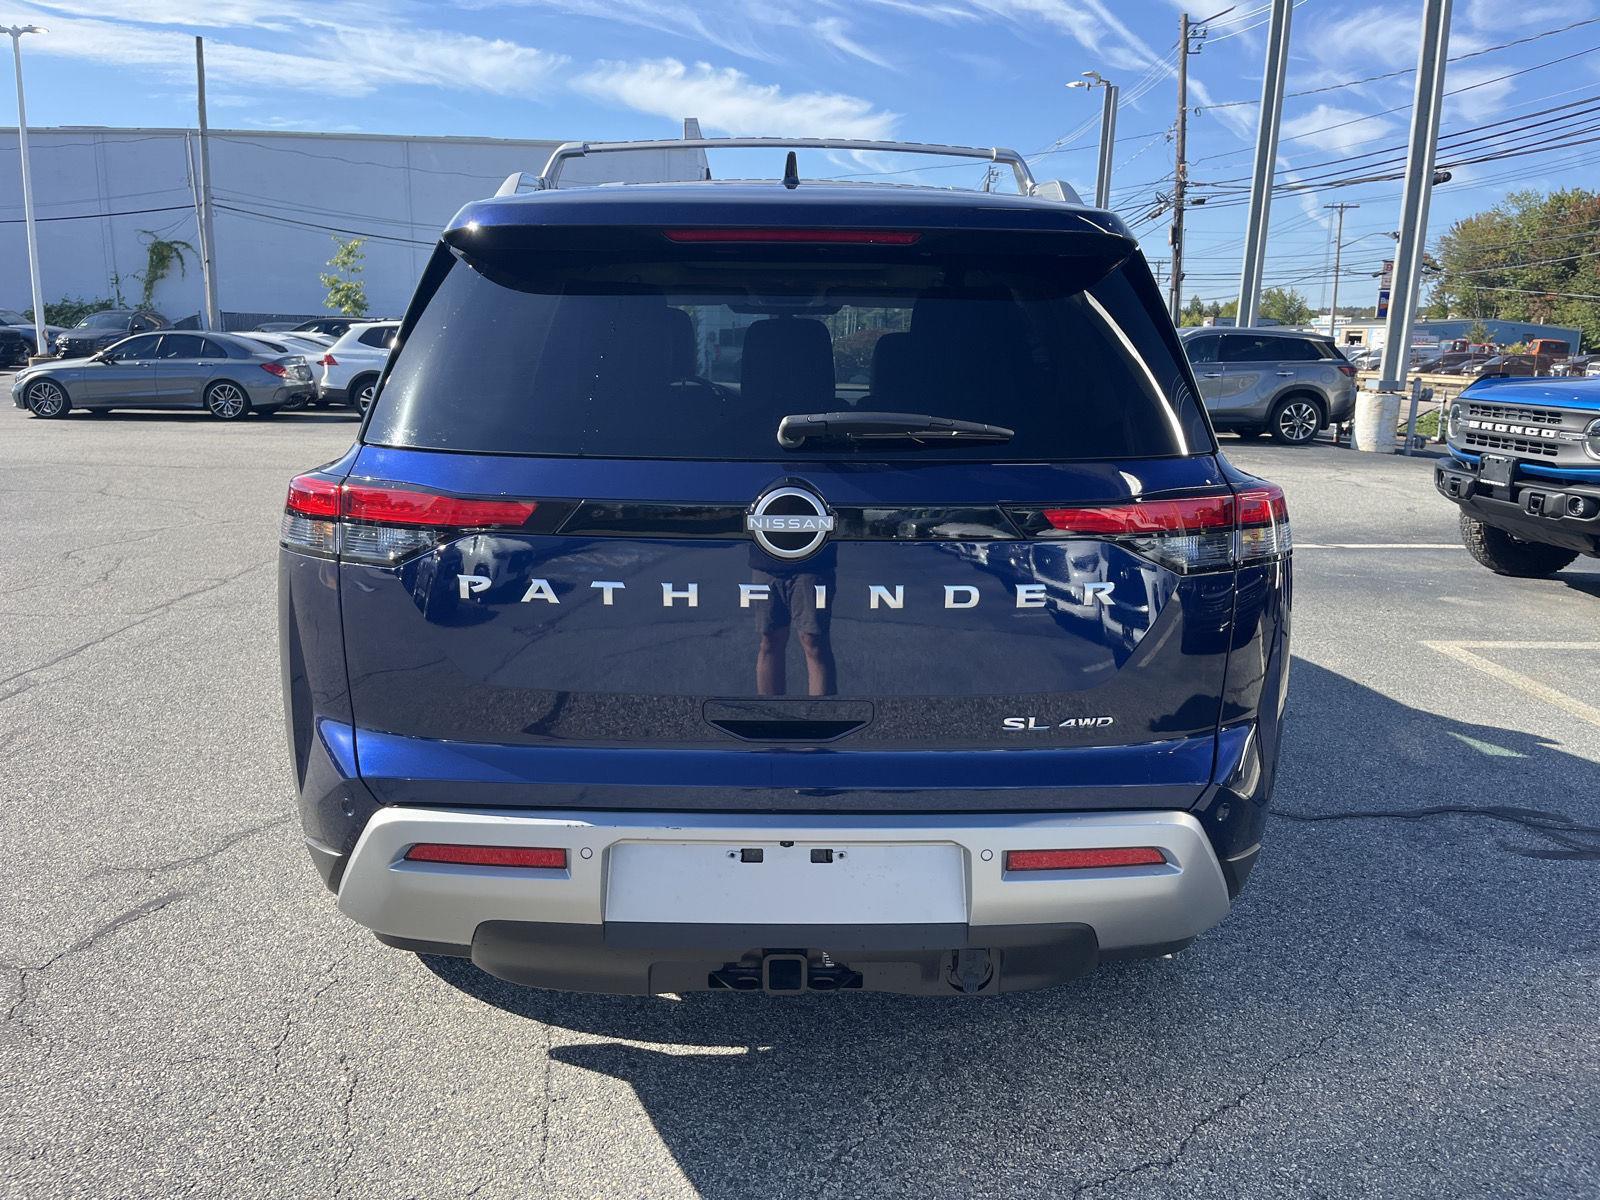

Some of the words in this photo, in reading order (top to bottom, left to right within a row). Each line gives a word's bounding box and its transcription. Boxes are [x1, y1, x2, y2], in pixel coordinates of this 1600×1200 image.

[1468, 420, 1557, 438] BRONCO
[750, 518, 831, 529] NISSAN
[457, 574, 1116, 609] PATHFINDER
[1002, 717, 1050, 730] SL
[1059, 717, 1114, 728] 4WD
